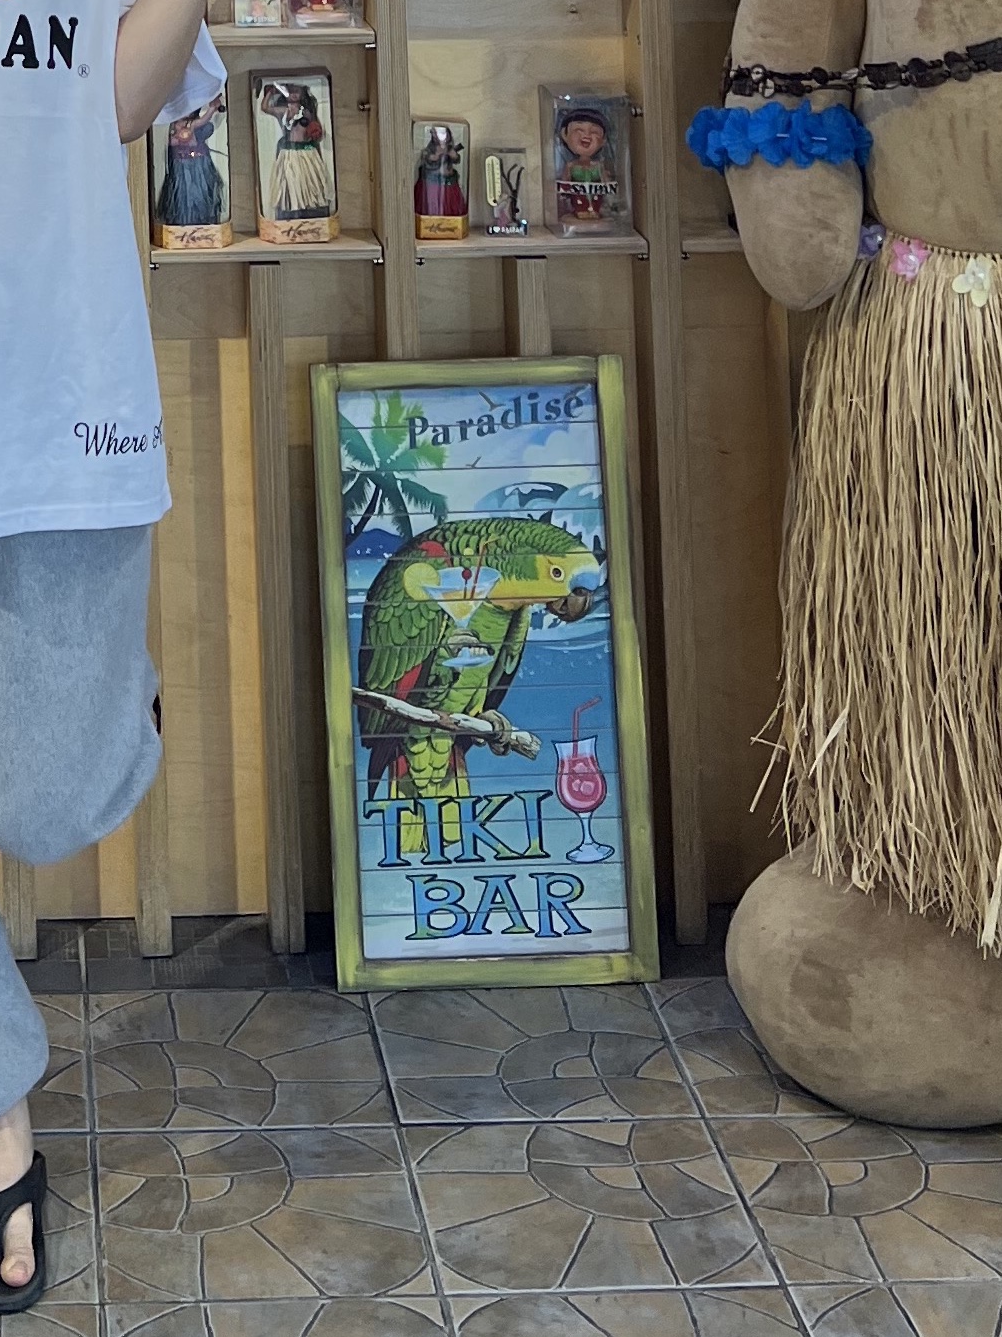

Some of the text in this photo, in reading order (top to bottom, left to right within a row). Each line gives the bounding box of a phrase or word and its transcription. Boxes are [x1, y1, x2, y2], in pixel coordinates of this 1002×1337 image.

[571, 183, 617, 194] SAIPAN
[74, 422, 148, 457] Where
[404, 392, 585, 450] Paradise
[363, 789, 554, 867] TIKI
[405, 871, 592, 940] BAR
